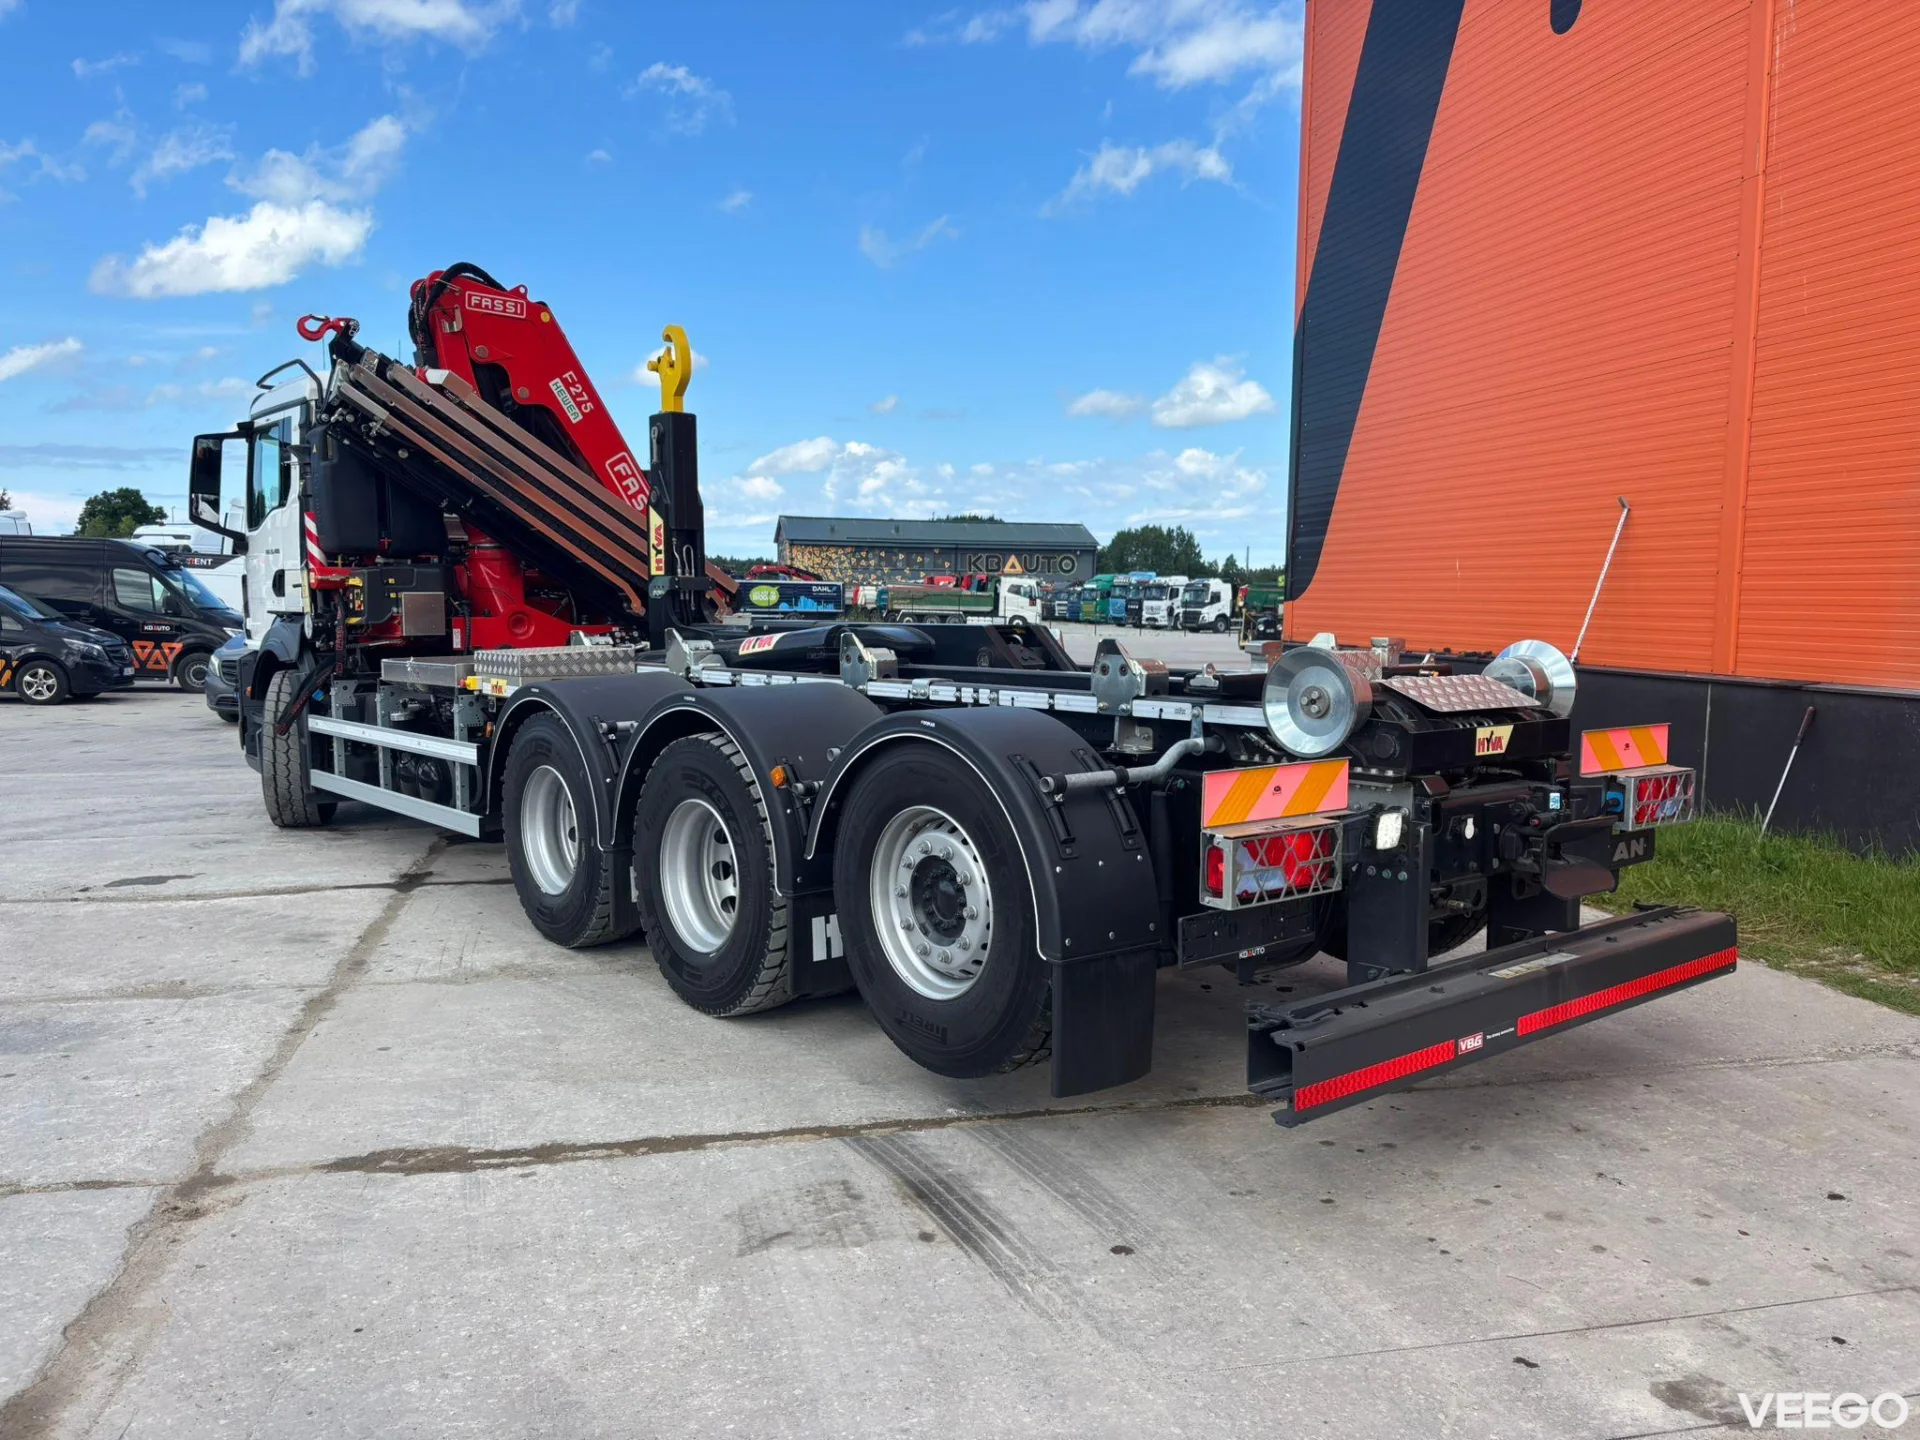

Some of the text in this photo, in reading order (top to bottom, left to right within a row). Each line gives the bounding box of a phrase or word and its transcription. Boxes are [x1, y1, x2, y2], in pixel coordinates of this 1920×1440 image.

[470, 295, 521, 314] FASSI
[562, 370, 594, 413] F275
[613, 462, 649, 511] FAS
[652, 524, 663, 572] HYVA
[1477, 730, 1504, 753] HYVA
[1612, 838, 1645, 861] AN
[1459, 1034, 1482, 1051] VBG
